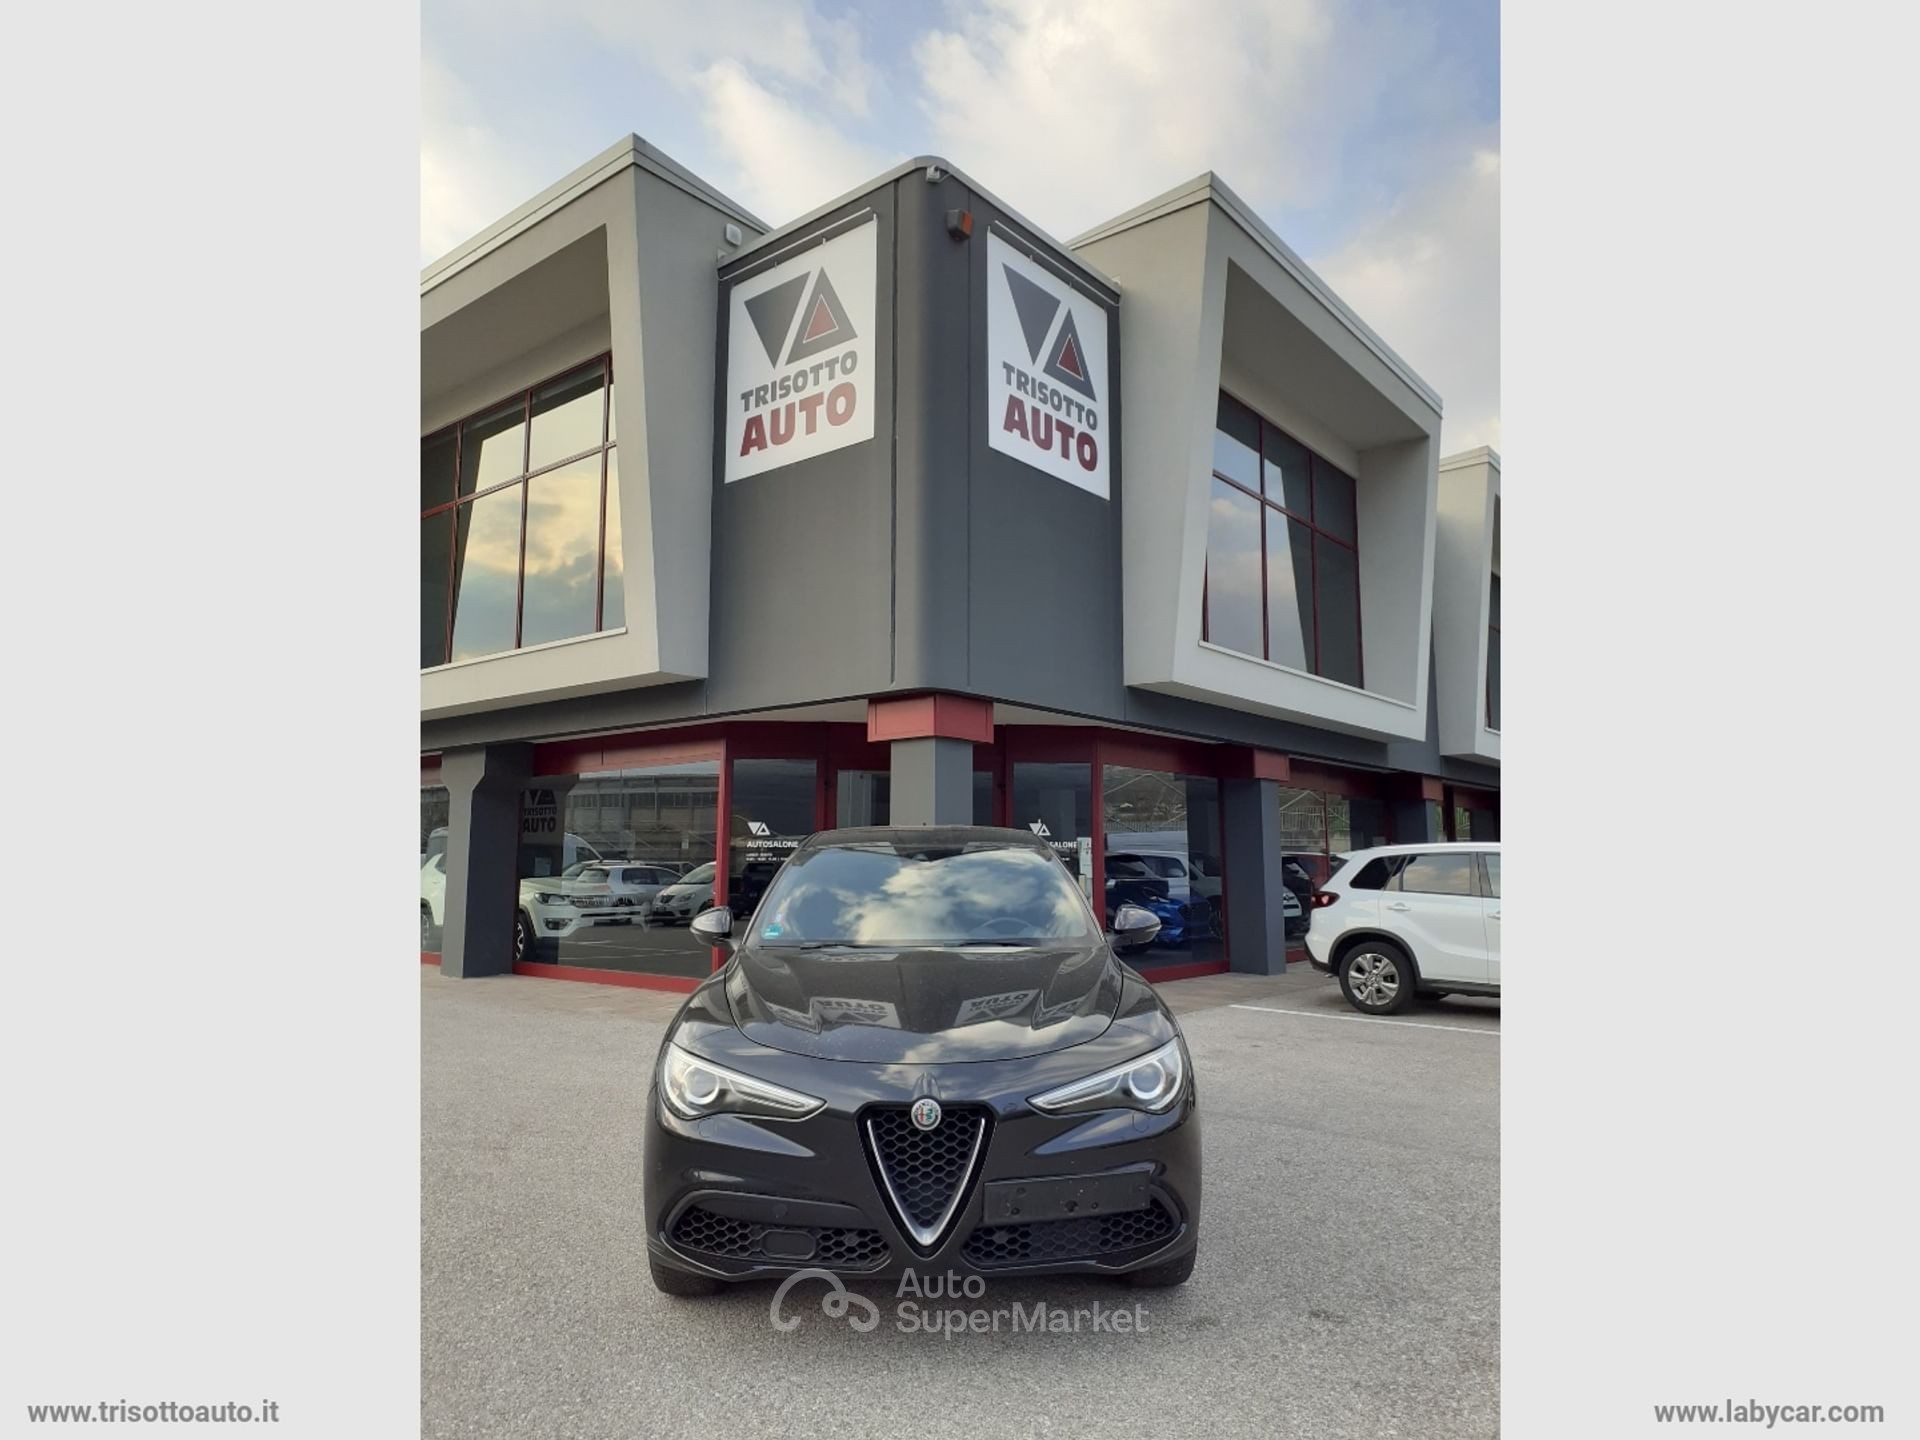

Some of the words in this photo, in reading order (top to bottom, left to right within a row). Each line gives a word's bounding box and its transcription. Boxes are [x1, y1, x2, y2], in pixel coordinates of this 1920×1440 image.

[740, 350, 858, 413] TRISOTTO
[1002, 360, 1098, 431] TRISOTTO
[739, 381, 857, 458] AUTO
[1003, 393, 1098, 472] AUTO
[522, 816, 557, 833] AUTO
[746, 840, 799, 848] AUTOSALONE
